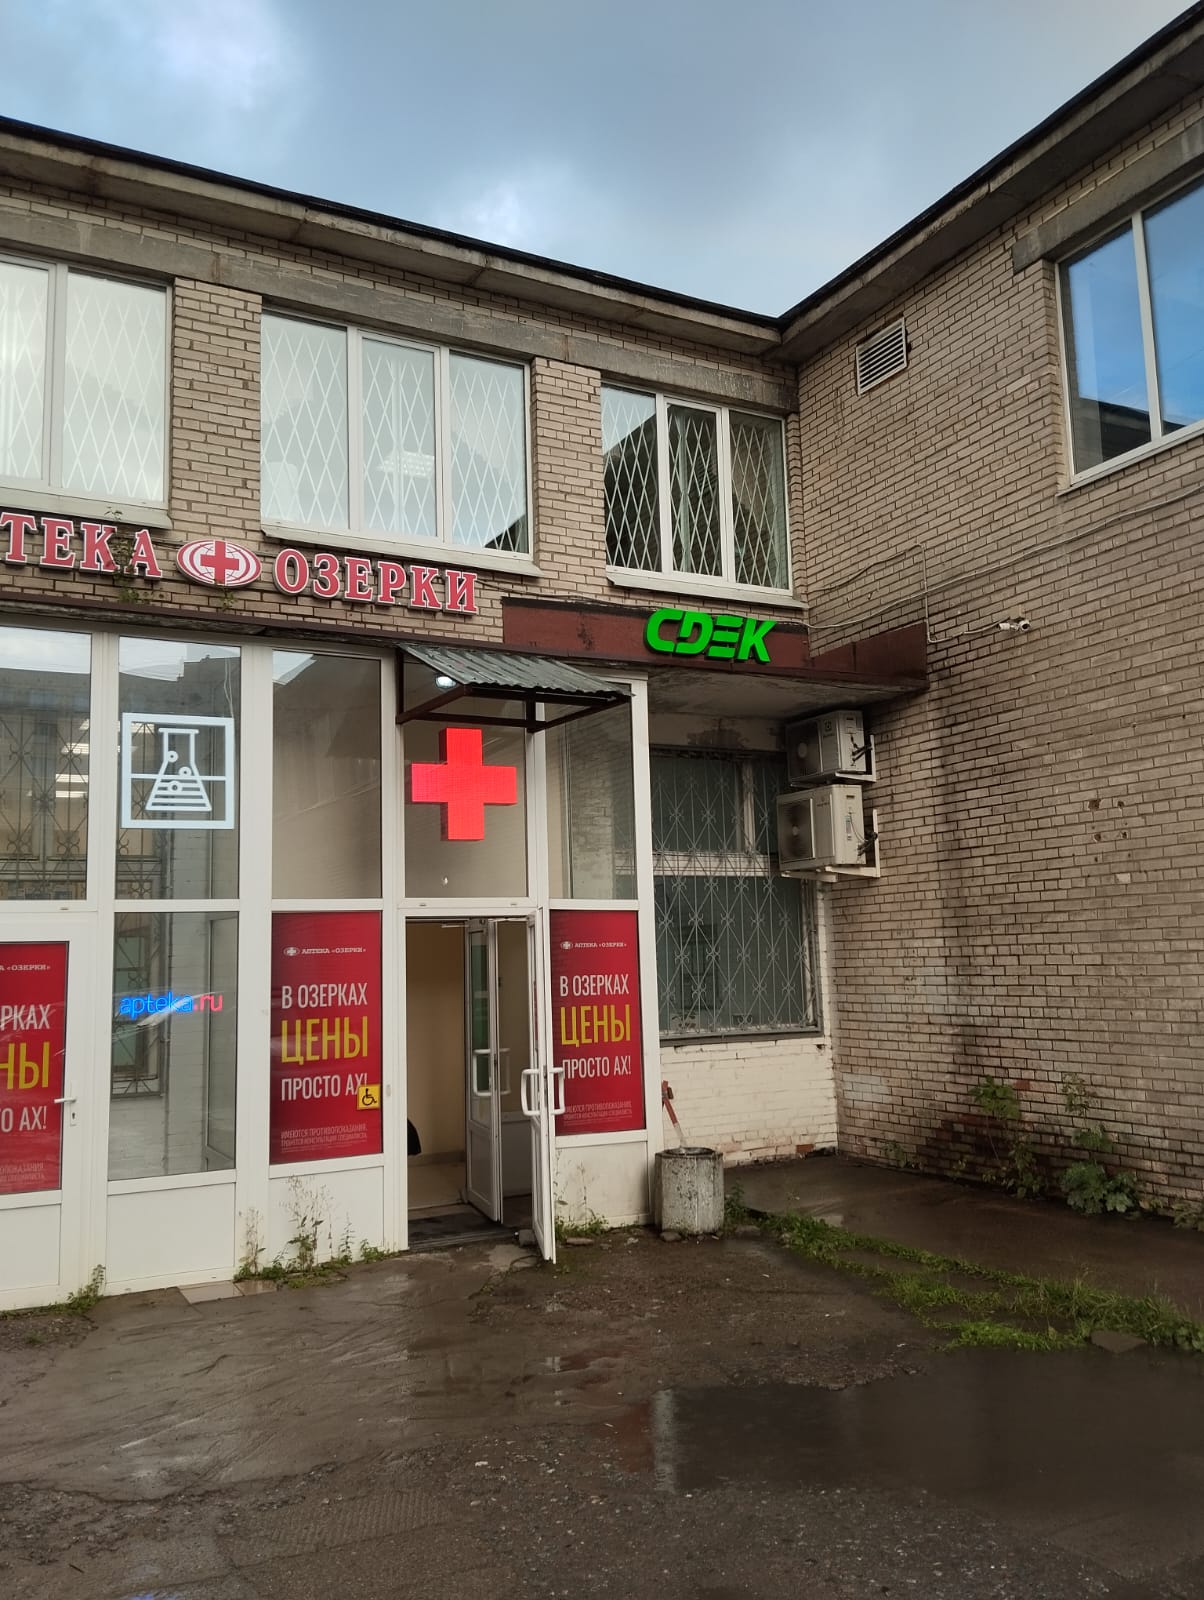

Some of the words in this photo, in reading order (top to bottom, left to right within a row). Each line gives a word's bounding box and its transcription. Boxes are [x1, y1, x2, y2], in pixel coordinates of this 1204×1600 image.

[0, 512, 163, 578] ТЕКА
[275, 549, 478, 613] ОЗЕРКИ
[645, 607, 778, 663] CDEK
[281, 985, 293, 1009] В
[297, 982, 368, 1008] ОЗЕРКАХ
[560, 976, 569, 997] В
[572, 974, 630, 996] ОЗЕРКАХ
[119, 990, 223, 1020] apteka.ru
[281, 1015, 368, 1066] ЦЕНЫ
[560, 1004, 631, 1048] ЦЕНЫ
[563, 1056, 610, 1080] ПРОСТО
[613, 1055, 632, 1076] АХ!
[281, 1074, 341, 1102] ПРОСТО
[19, 1105, 47, 1131] АХ!
